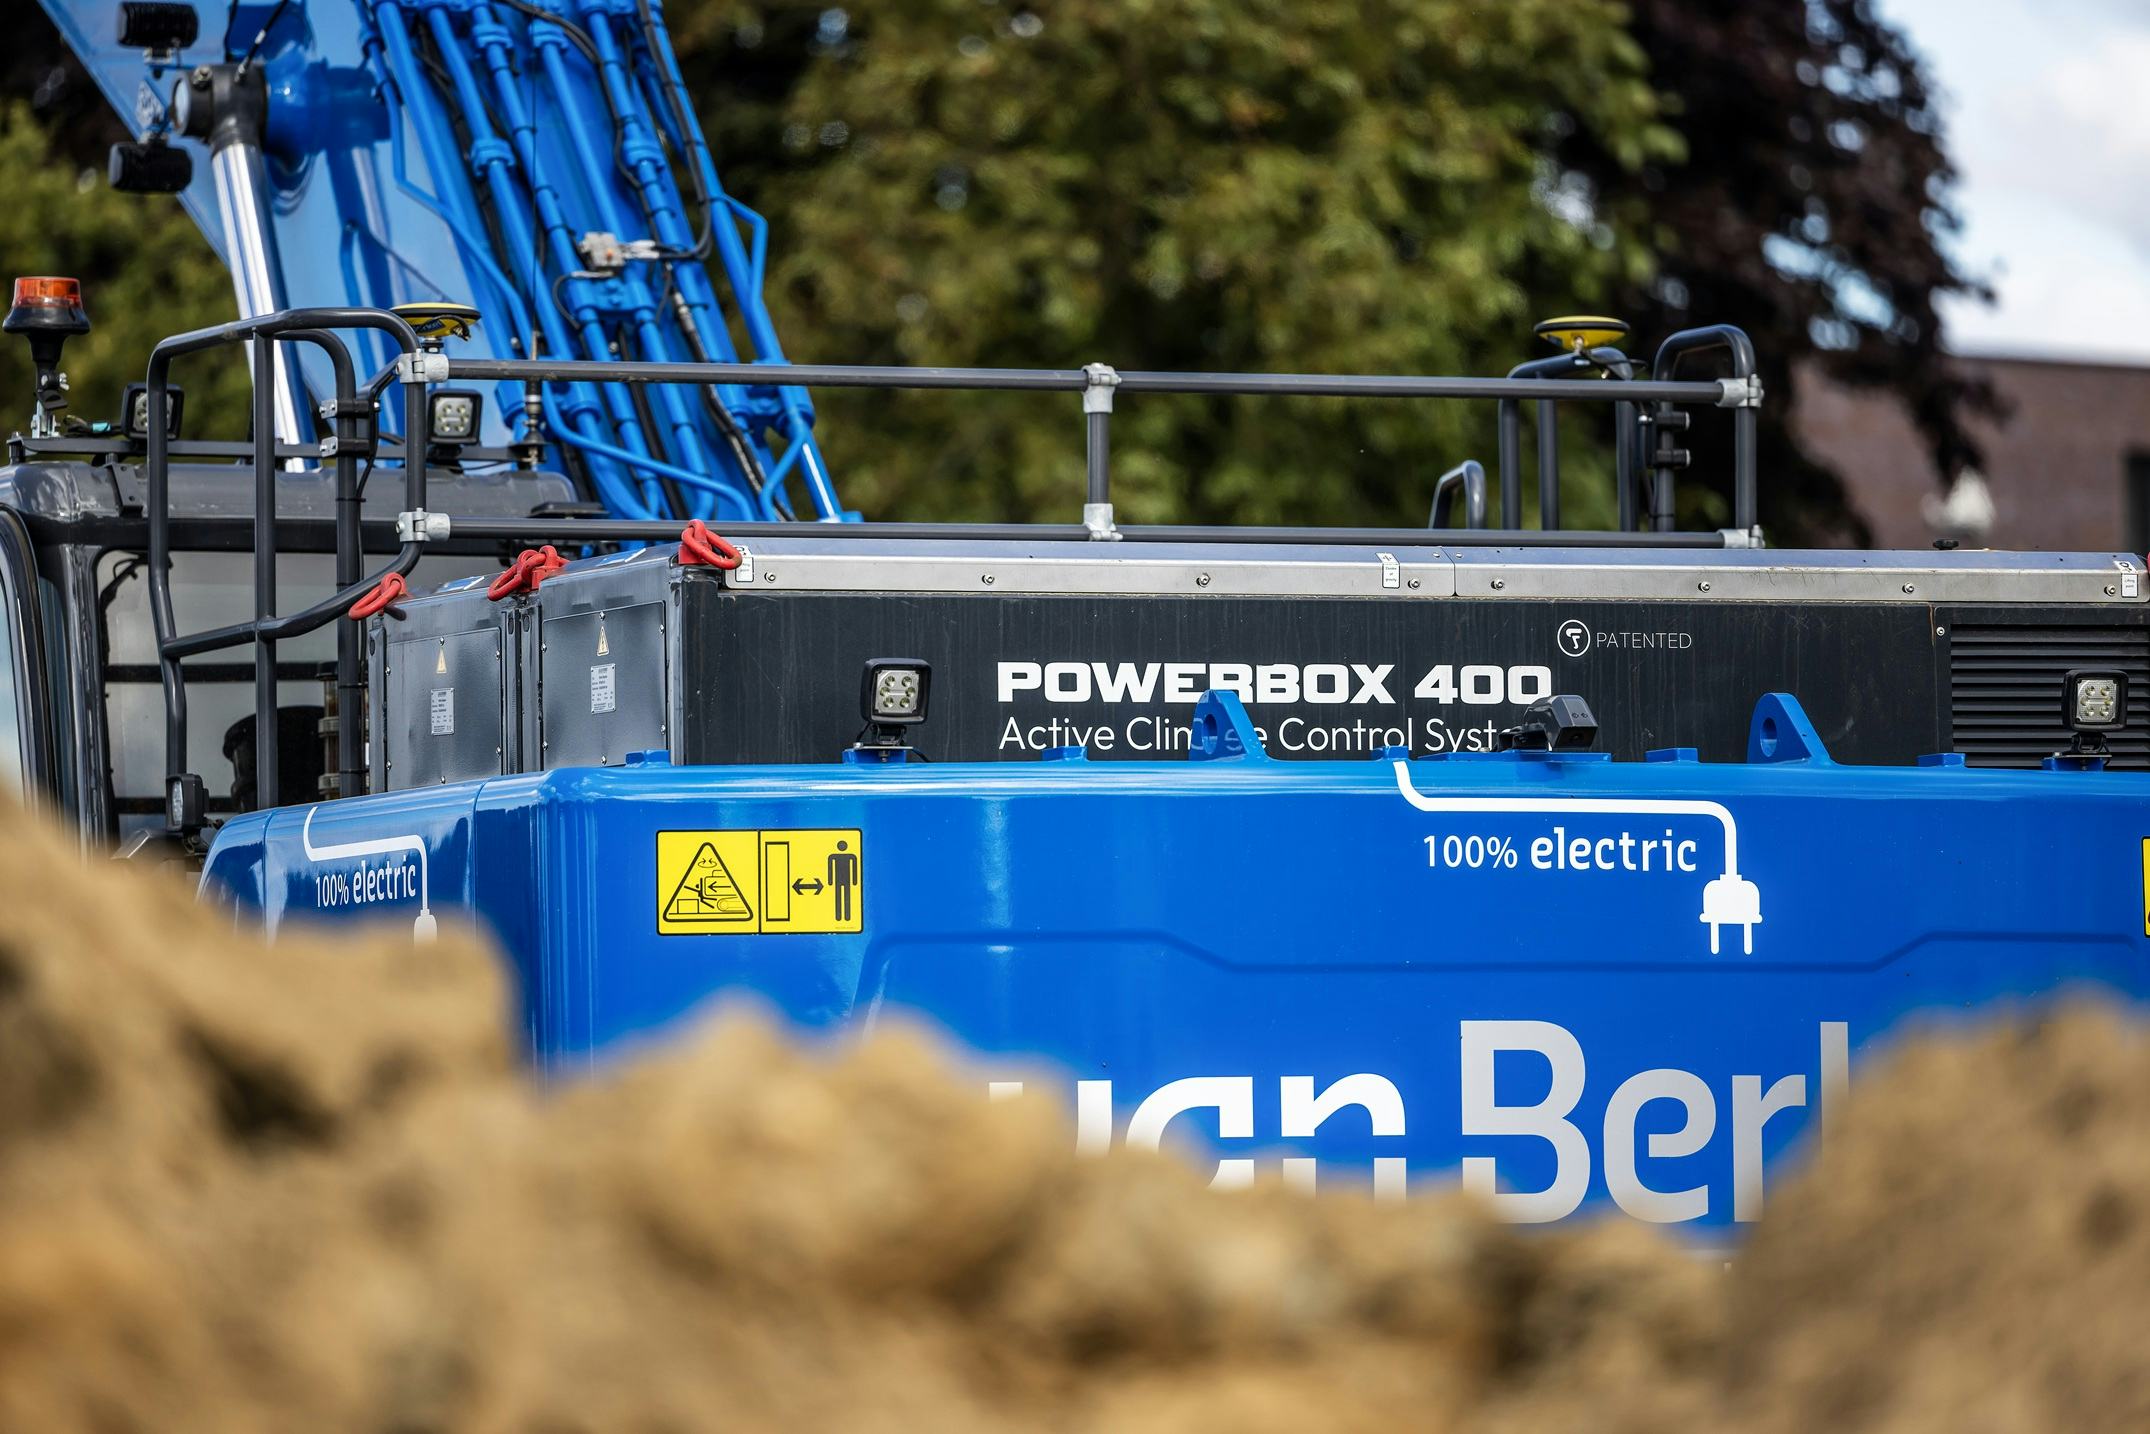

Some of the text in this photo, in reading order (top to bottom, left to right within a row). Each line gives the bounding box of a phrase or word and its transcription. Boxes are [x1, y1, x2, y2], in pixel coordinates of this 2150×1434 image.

[1596, 632, 1692, 649] PATENTED
[997, 662, 1552, 705] POWERBOX 400
[999, 716, 1115, 750] Active
[1125, 716, 1268, 751] Clime
[1278, 717, 1413, 751] Control
[1423, 827, 1697, 872] 100% electric
[315, 855, 416, 908] 100% electric
